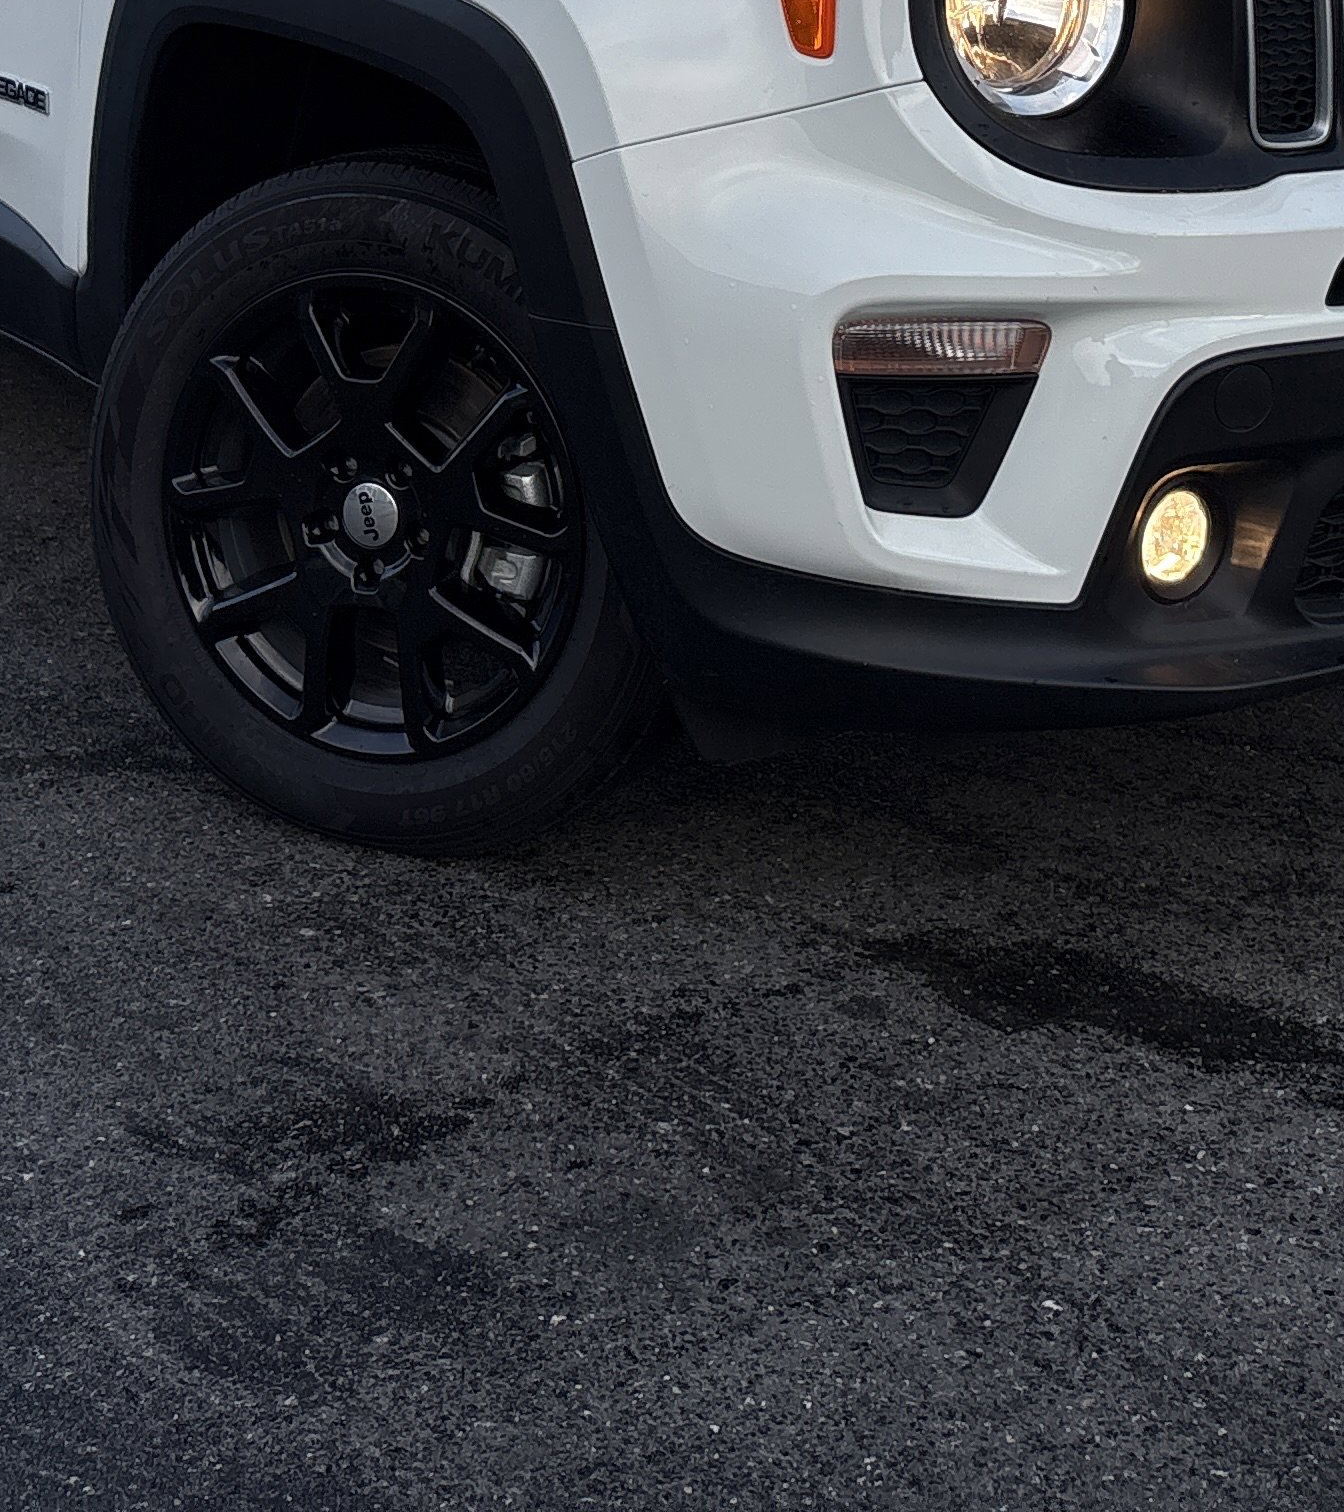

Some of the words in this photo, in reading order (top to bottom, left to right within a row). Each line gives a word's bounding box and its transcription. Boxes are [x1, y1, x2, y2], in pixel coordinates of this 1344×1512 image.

[145, 223, 271, 346] SOLUS
[429, 223, 524, 303] KUM
[358, 491, 380, 541] Jeep
